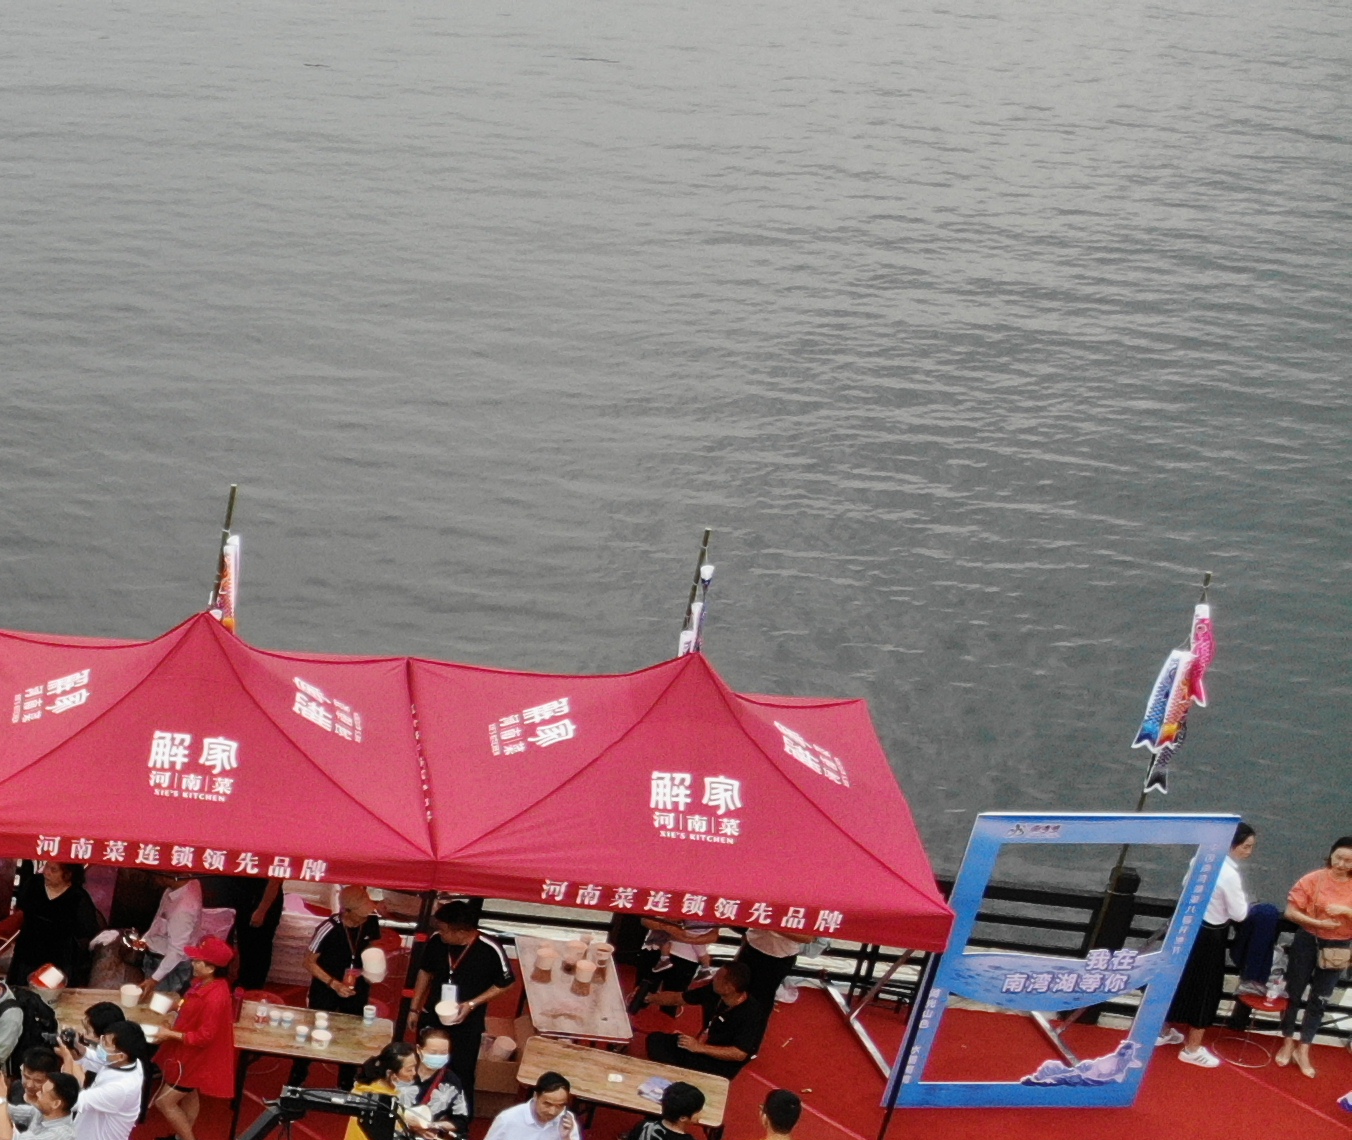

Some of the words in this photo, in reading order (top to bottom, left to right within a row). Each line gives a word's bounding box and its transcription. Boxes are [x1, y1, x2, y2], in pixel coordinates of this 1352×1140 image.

[148, 731, 239, 775] 解家
[182, 791, 226, 803] KITCHEN
[650, 771, 742, 815] 解家
[689, 833, 734, 844] KITCHEN
[36, 834, 328, 882] 河南菜连锁领先品牌
[541, 879, 844, 933] 河南菜连锁领先品牌
[1085, 949, 1139, 971] 我在
[1001, 972, 1129, 993] 南湾湖等你
